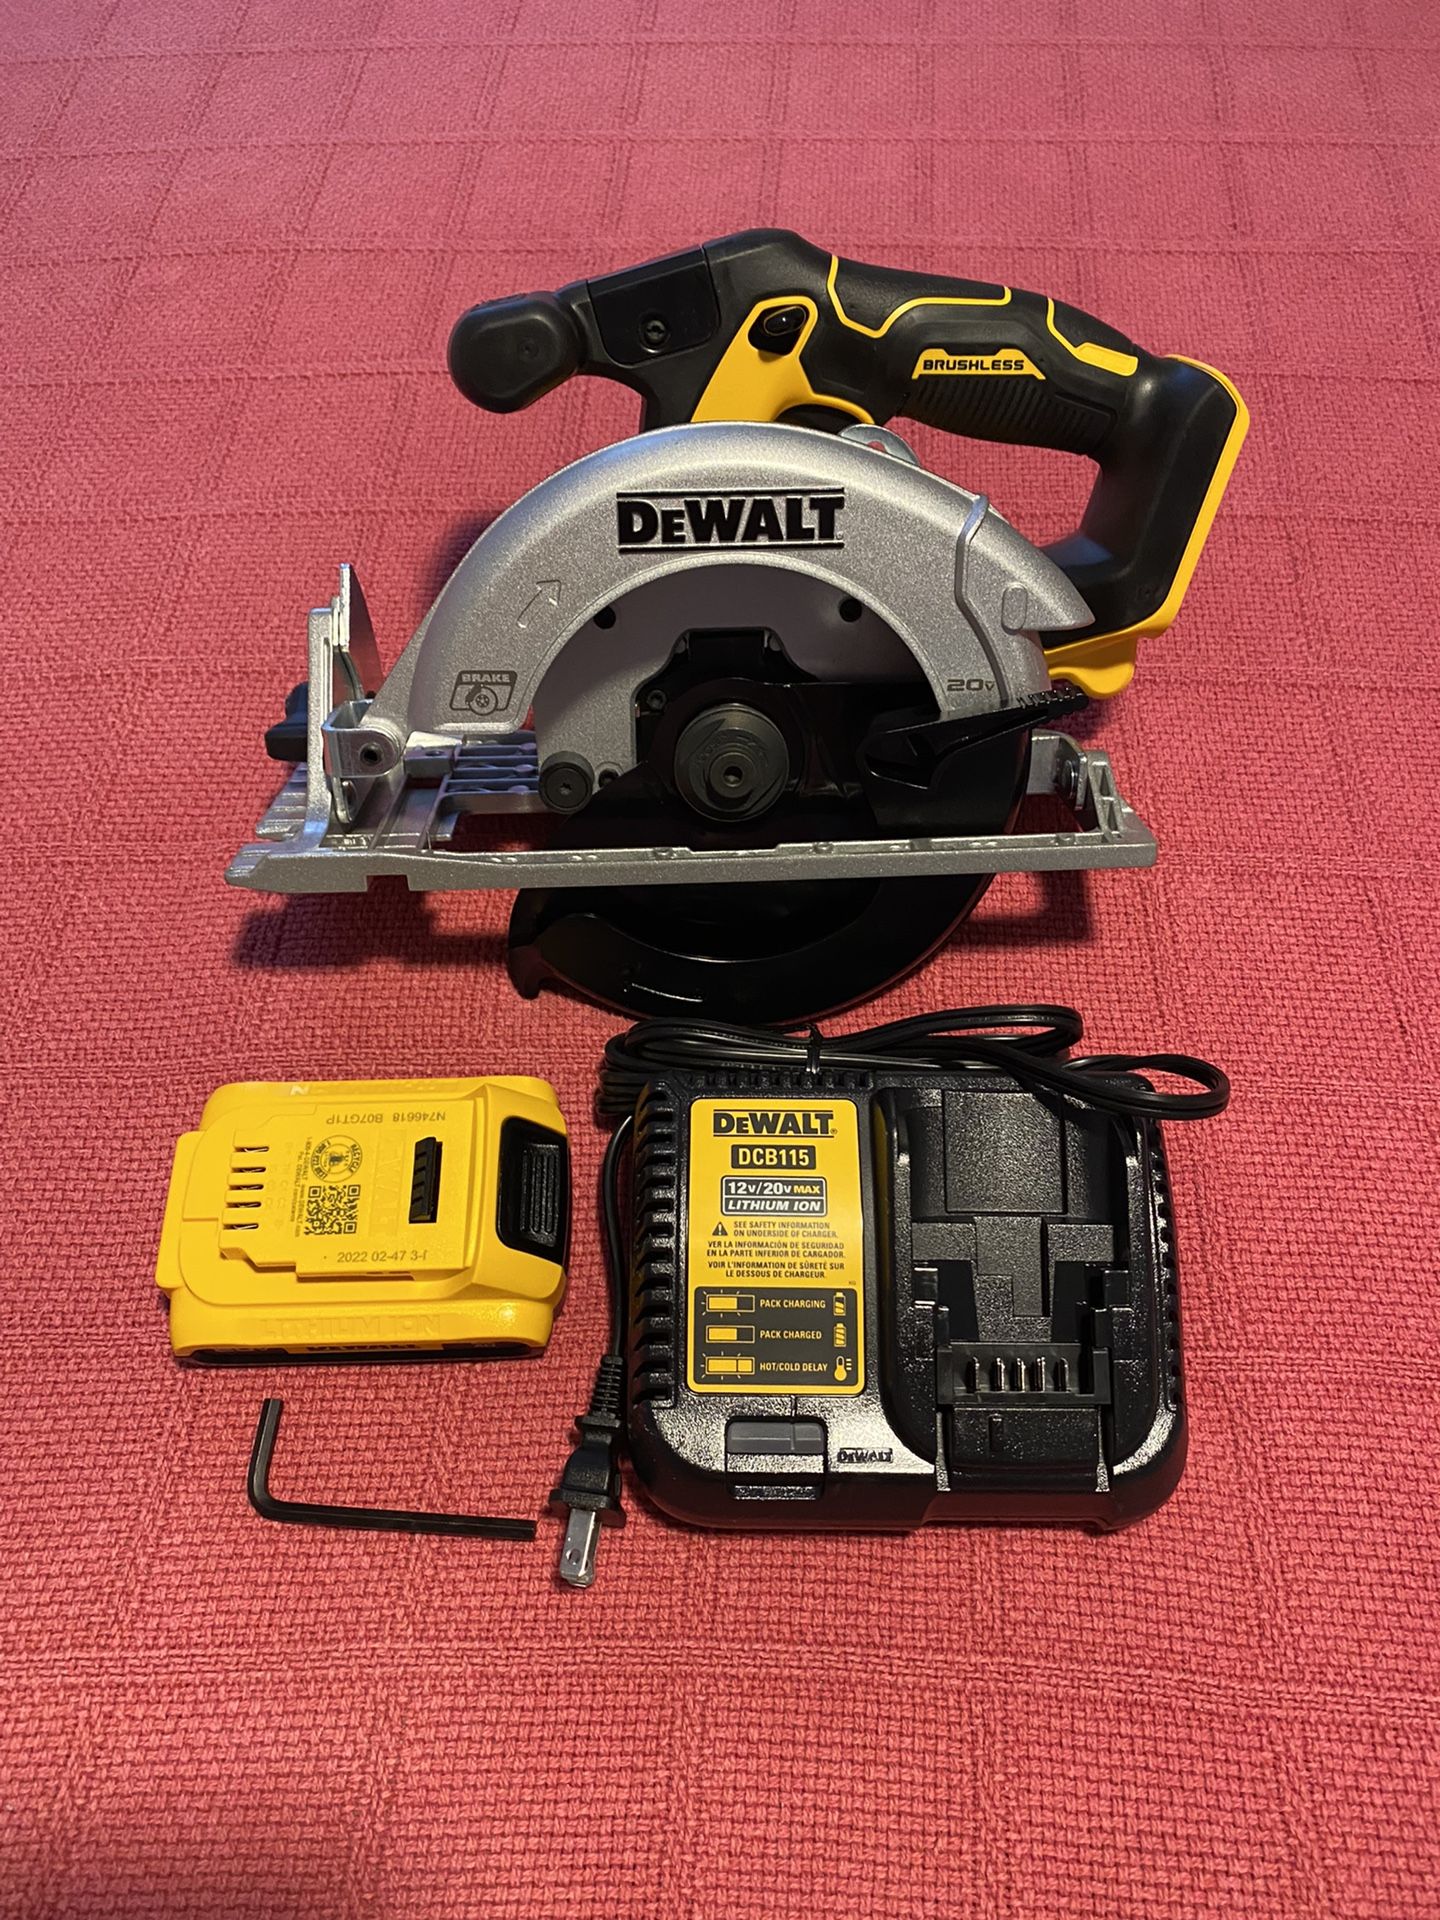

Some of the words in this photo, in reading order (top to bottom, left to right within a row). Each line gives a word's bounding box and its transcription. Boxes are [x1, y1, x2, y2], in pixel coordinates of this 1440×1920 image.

[923, 359, 1024, 371] BRUSHLESS
[461, 673, 511, 683] BRAKE
[326, 1113, 384, 1125] B07GT1P
[392, 1111, 446, 1122] N746618
[738, 1147, 810, 1166] DCB115
[793, 1185, 821, 1194] MAX
[728, 1200, 789, 1211] LITHIUM
[793, 1201, 821, 1211] ION
[733, 1221, 747, 1229] SEE
[749, 1221, 776, 1229] SAFETY
[733, 1229, 745, 1237] ON
[801, 1230, 838, 1238] CHARGER.
[708, 1241, 722, 1249] VER
[723, 1241, 734, 1249] LA
[735, 1240, 789, 1249] INFORMACIÓN
[790, 1241, 800, 1249] DE
[801, 1241, 845, 1250] SEGURIDAD
[337, 1250, 369, 1263] 2022
[371, 1249, 407, 1262] 02-47
[706, 1249, 717, 1257] EN
[718, 1249, 729, 1257] LA
[730, 1249, 753, 1257] PARTE
[755, 1250, 789, 1258] INFERIOR
[790, 1250, 801, 1258] DE
[801, 1250, 846, 1258] CARGADOR.
[708, 1261, 726, 1269] VOIR
[727, 1261, 786, 1269] L'INFORMATION
[799, 1260, 828, 1270] SÛRETÉ
[829, 1262, 845, 1270] SUR
[725, 1270, 735, 1278] LE
[736, 1270, 771, 1278] DESSOUS
[773, 1270, 783, 1278] DE
[759, 1300, 782, 1308] PACK
[783, 1300, 826, 1309] CHARGING
[759, 1331, 782, 1339] PACK
[783, 1331, 822, 1339] CHARGED
[759, 1362, 801, 1372] HOT/COLD
[802, 1363, 828, 1372] DELAY
